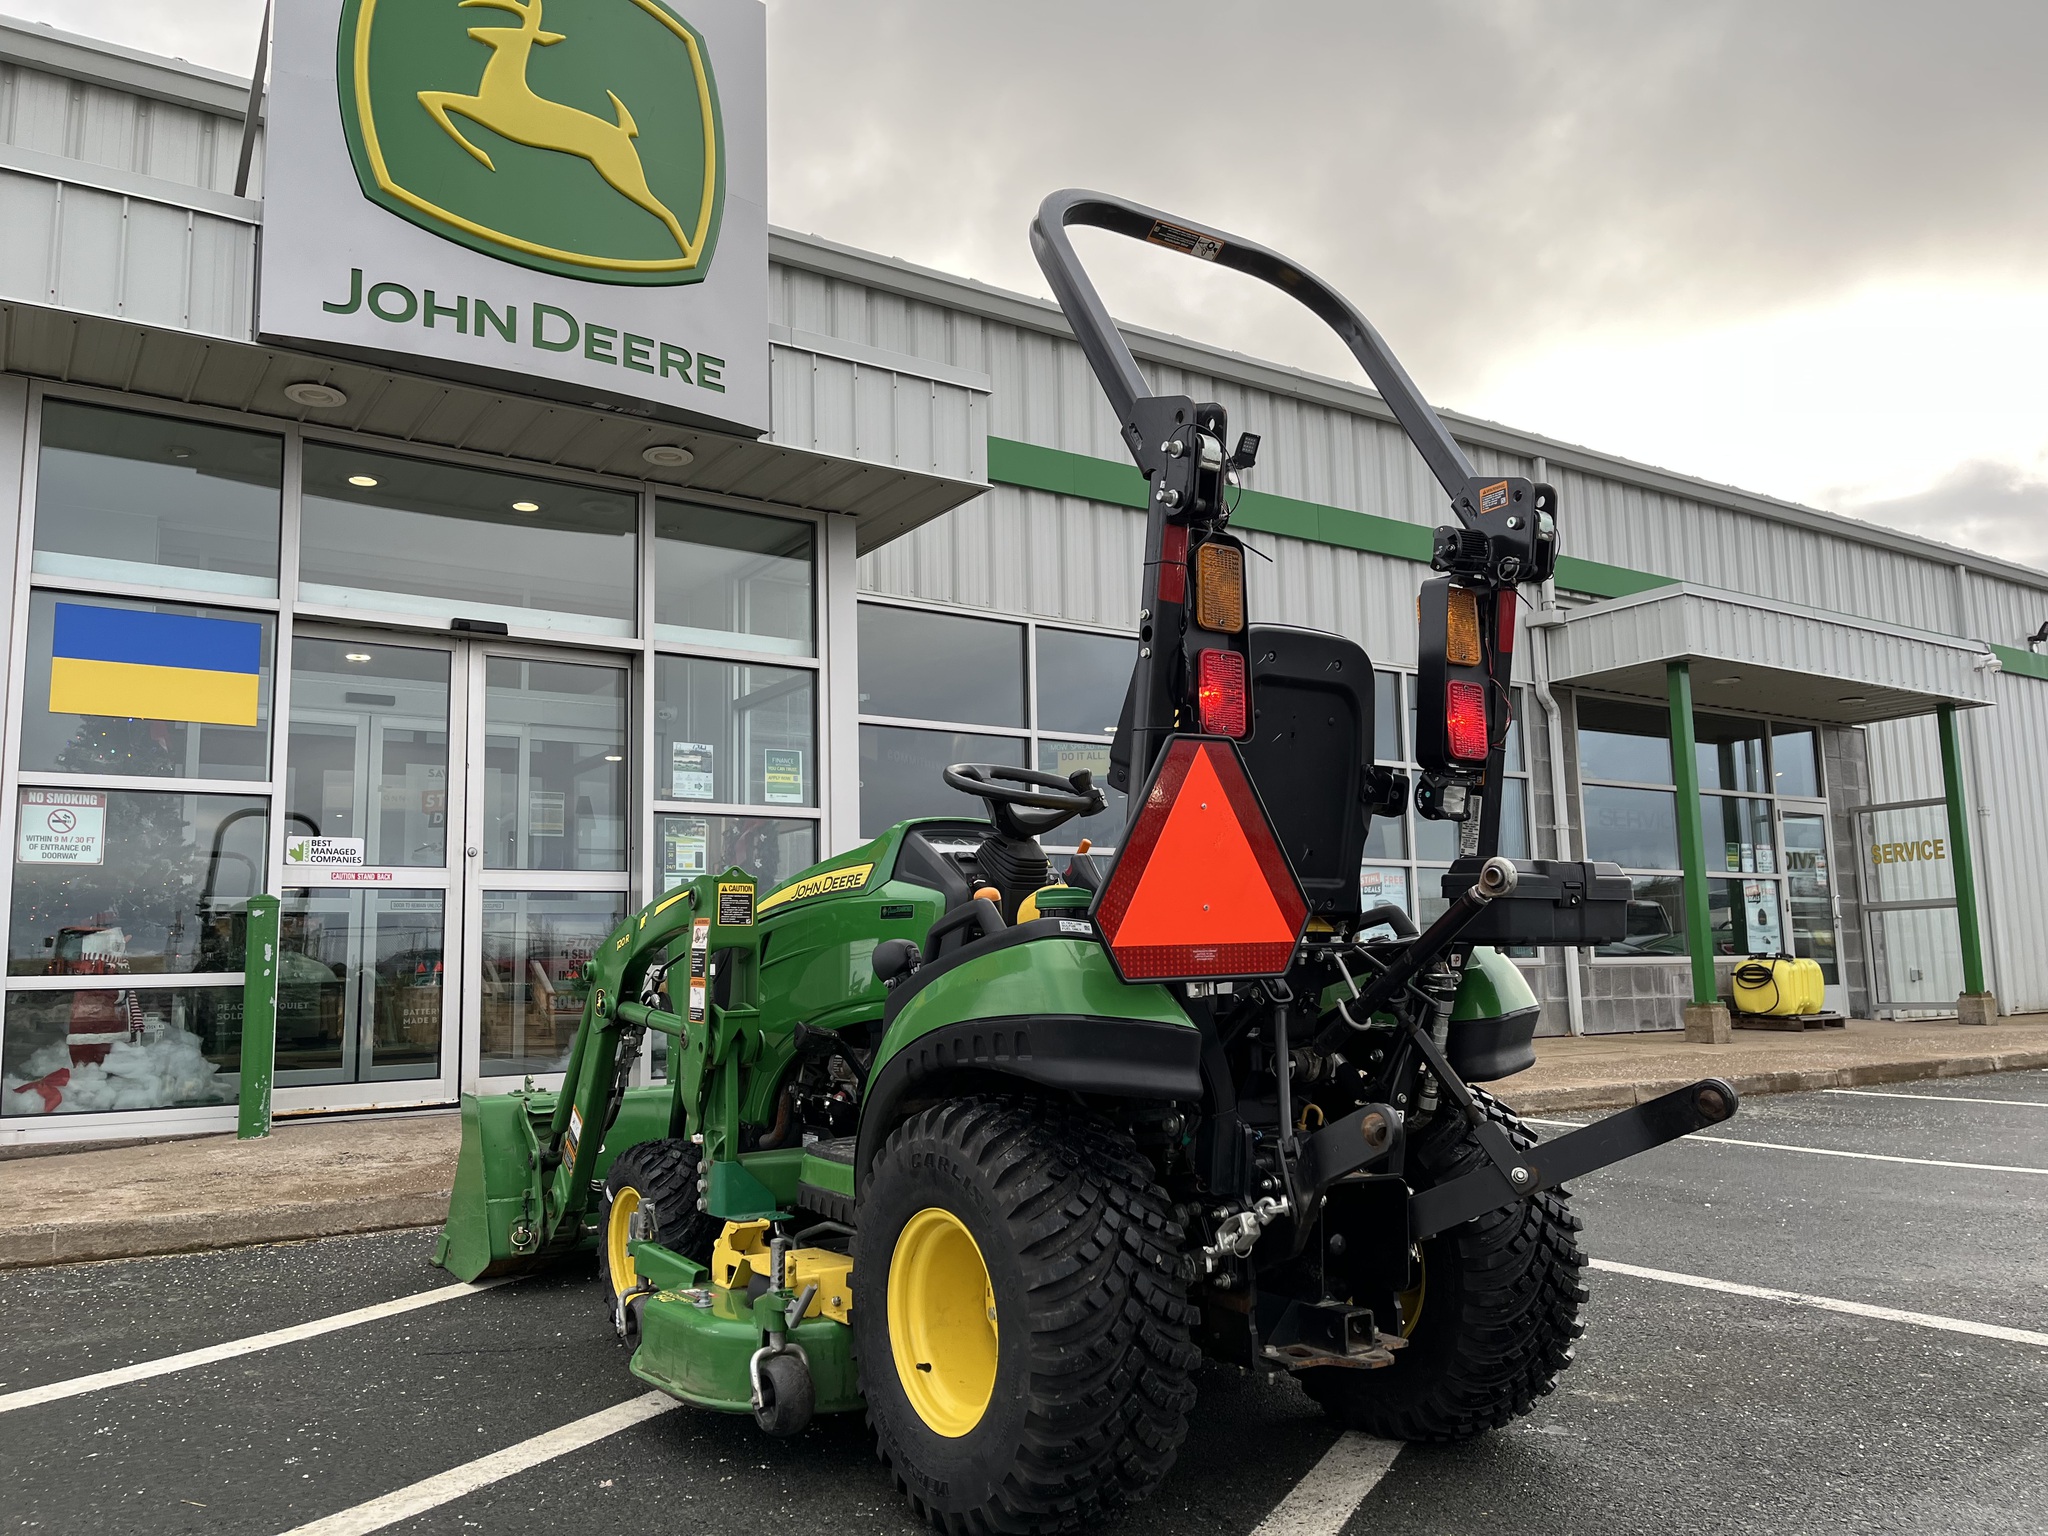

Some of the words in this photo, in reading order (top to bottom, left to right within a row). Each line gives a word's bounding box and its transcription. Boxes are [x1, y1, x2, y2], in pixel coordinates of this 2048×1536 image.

[322, 268, 517, 344] JOHN
[532, 302, 726, 394] DEERE
[1077, 752, 1085, 760] IT
[28, 792, 44, 803] NO
[46, 792, 98, 805] SMOKING
[1871, 839, 1946, 865] SERVICE
[332, 872, 355, 880] CAUTION
[1384, 876, 1404, 884] FREE
[791, 880, 821, 900] JOHN
[823, 873, 863, 892] DEERE
[217, 1003, 244, 1011] PEAC
[279, 1002, 309, 1010] QUIET
